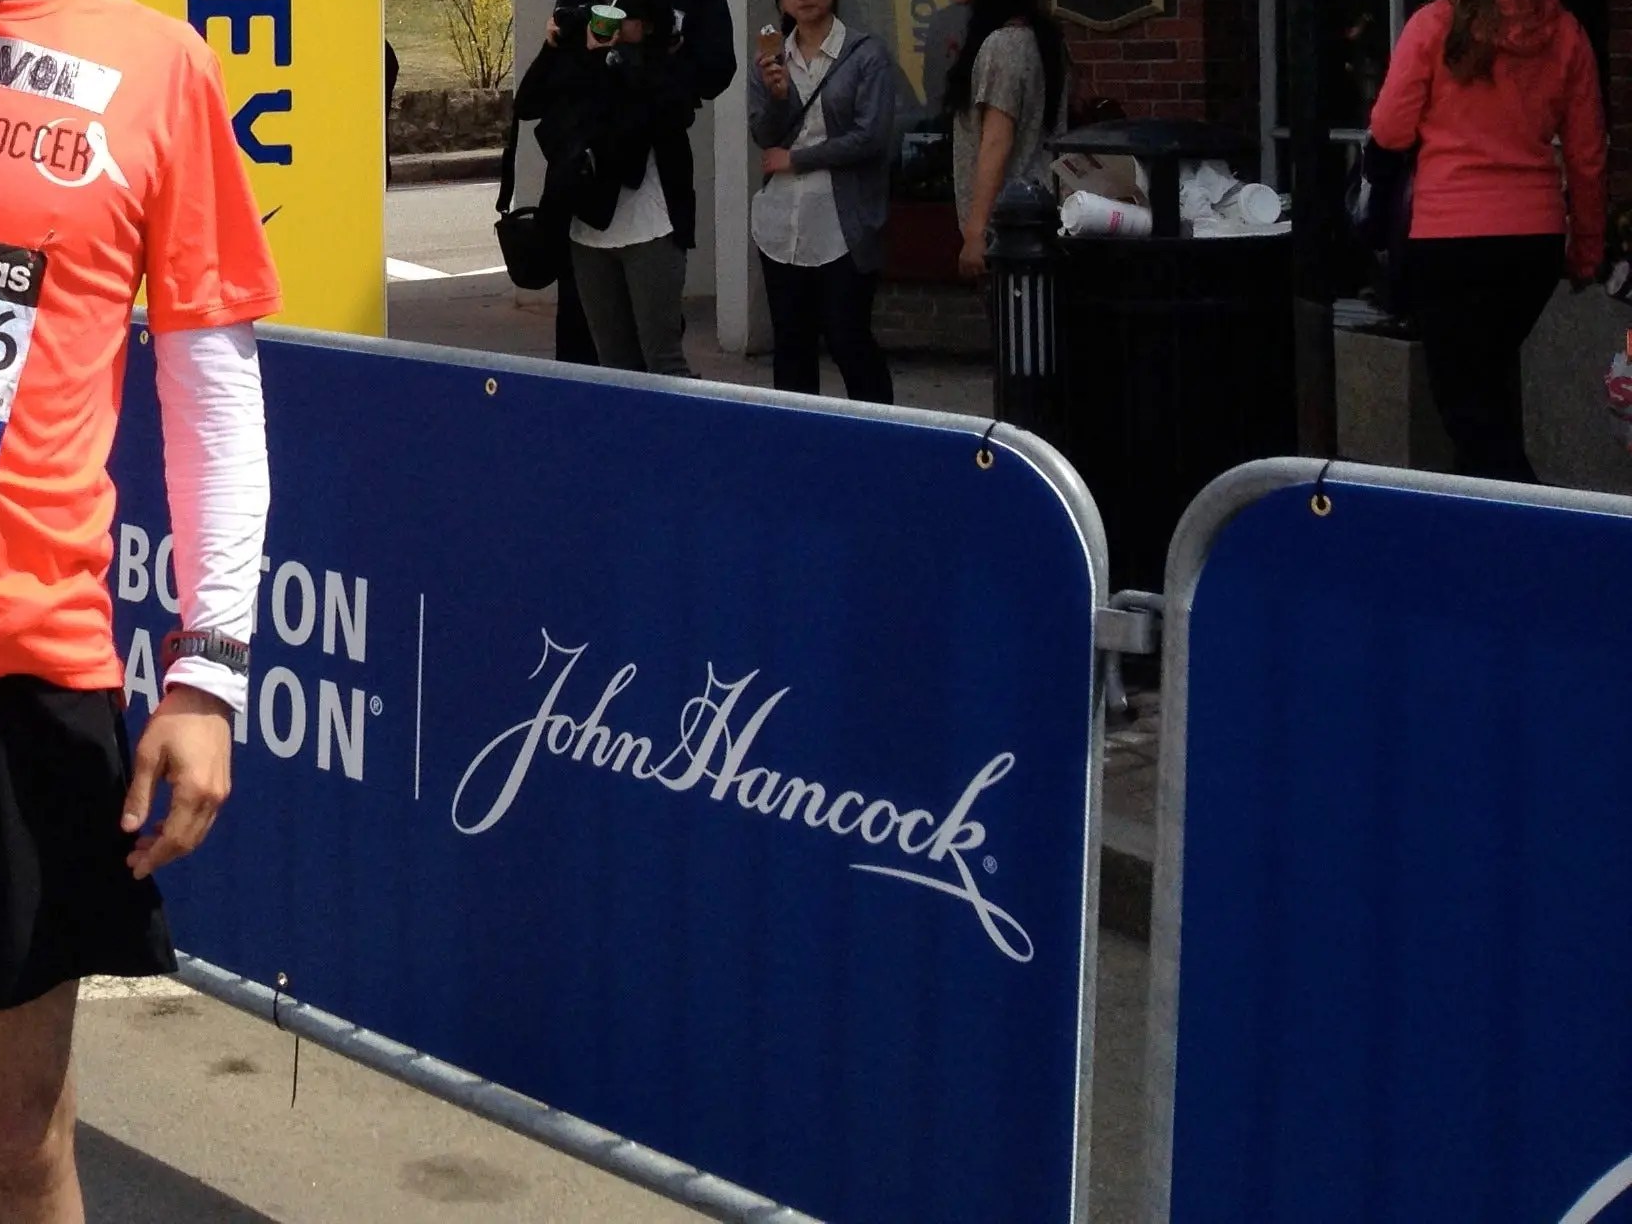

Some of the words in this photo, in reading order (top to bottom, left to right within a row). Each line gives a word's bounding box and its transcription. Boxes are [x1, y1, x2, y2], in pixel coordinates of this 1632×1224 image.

[118, 522, 368, 663] BOON
[452, 627, 654, 835] John
[649, 660, 1035, 964] Hancock
